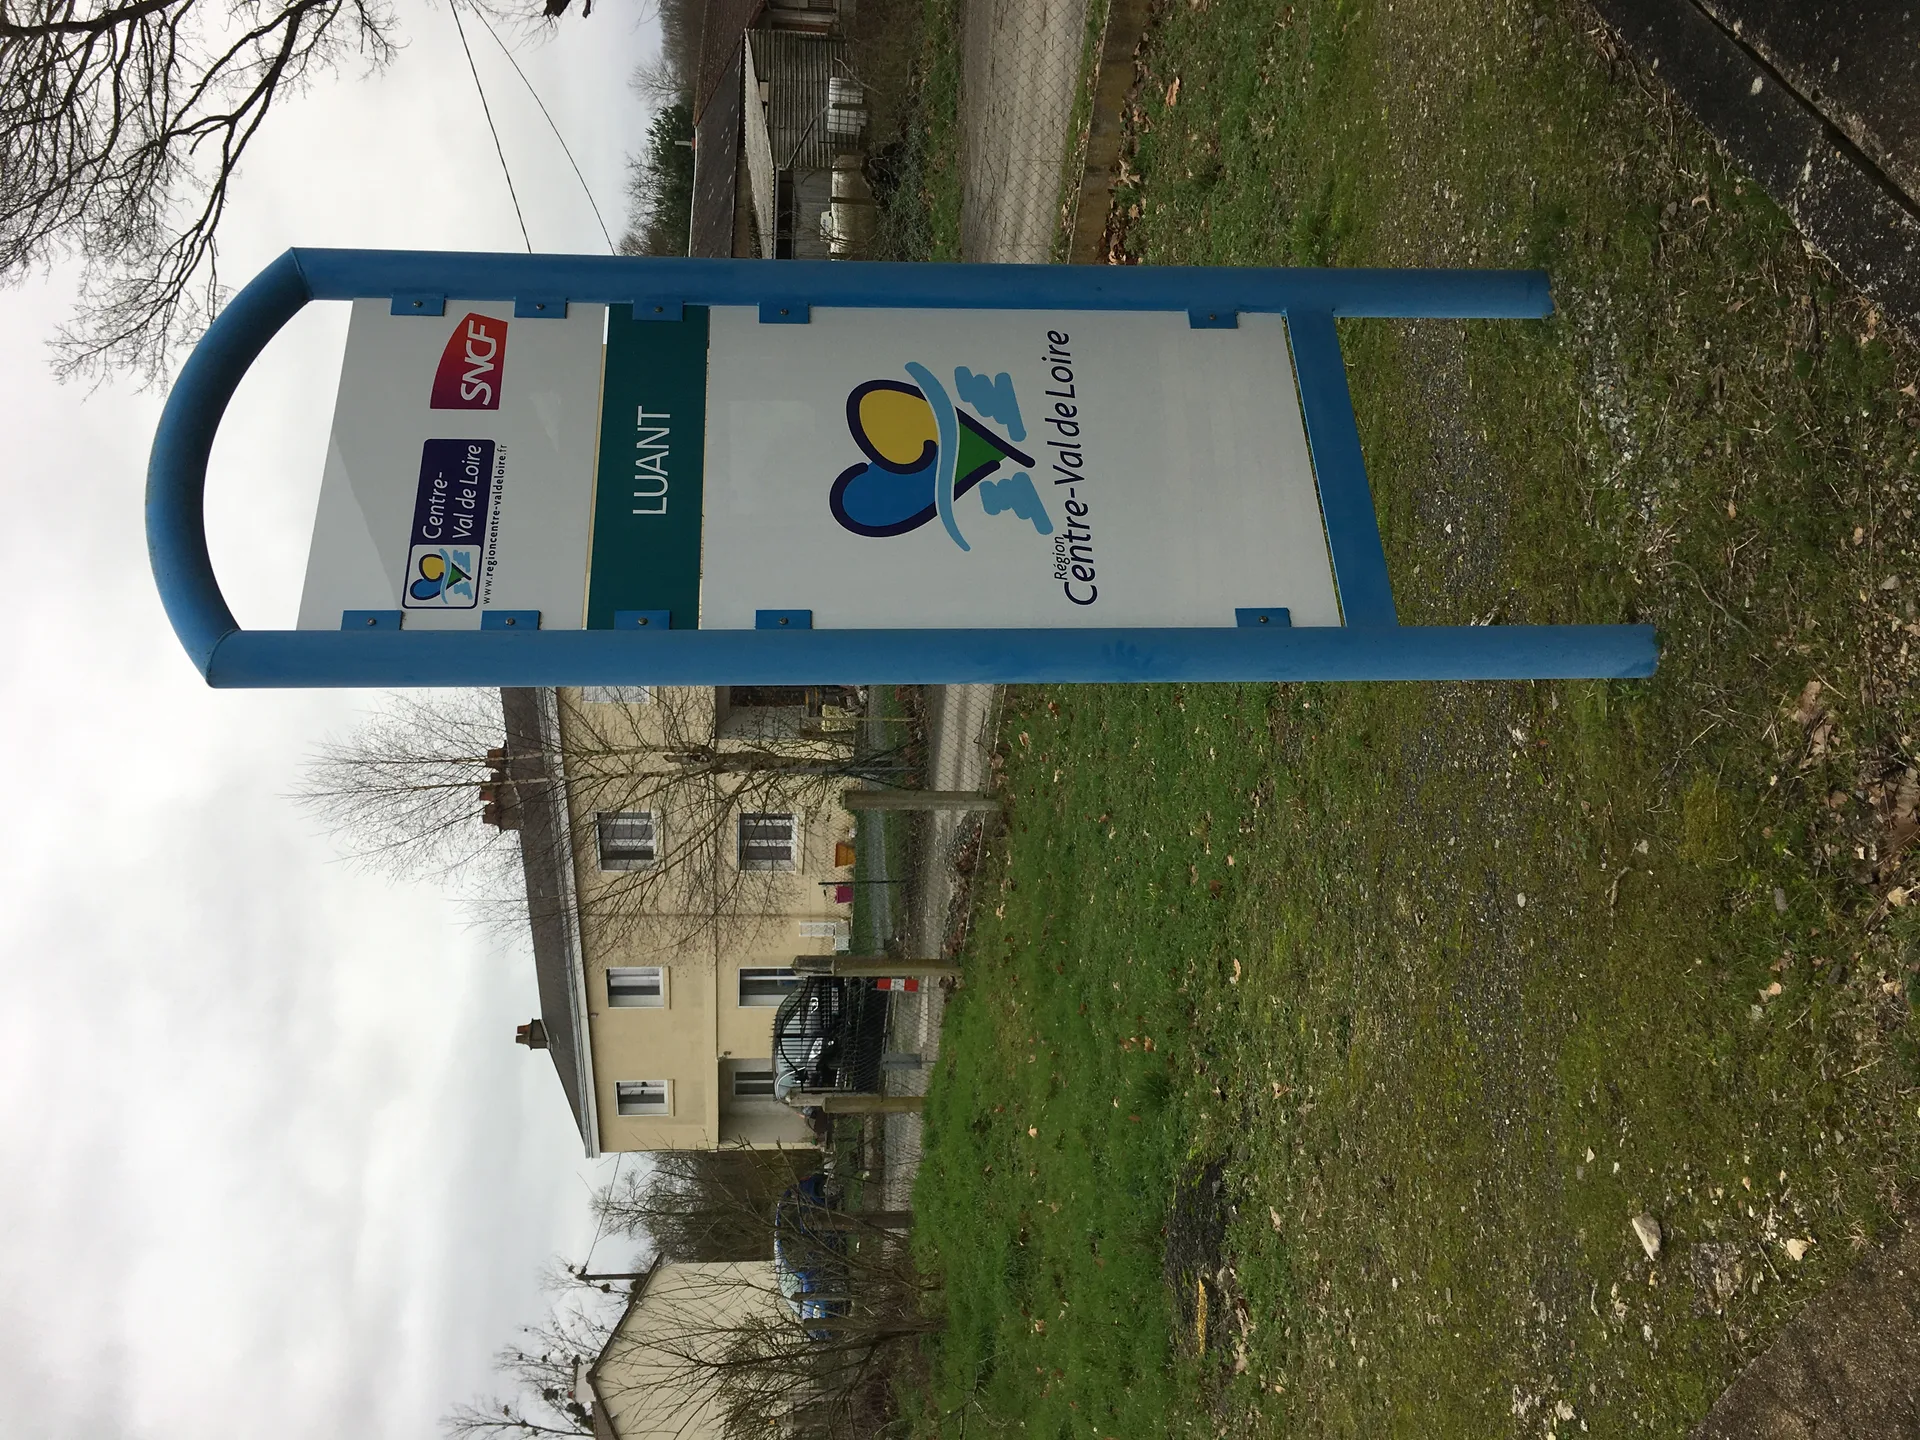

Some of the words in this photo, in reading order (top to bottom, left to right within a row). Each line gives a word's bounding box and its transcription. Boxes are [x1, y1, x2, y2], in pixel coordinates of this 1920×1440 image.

[460, 320, 497, 405] SNCF
[1041, 330, 1075, 399] Loire
[1045, 402, 1079, 437] de
[457, 445, 482, 485] Loire
[632, 406, 671, 515] LUANT
[422, 471, 449, 540] Centre-
[452, 512, 475, 540] Val
[454, 490, 477, 509] de
[482, 444, 507, 605] www.regioncentre-valdeloire.fr
[1052, 536, 1070, 581] Région
